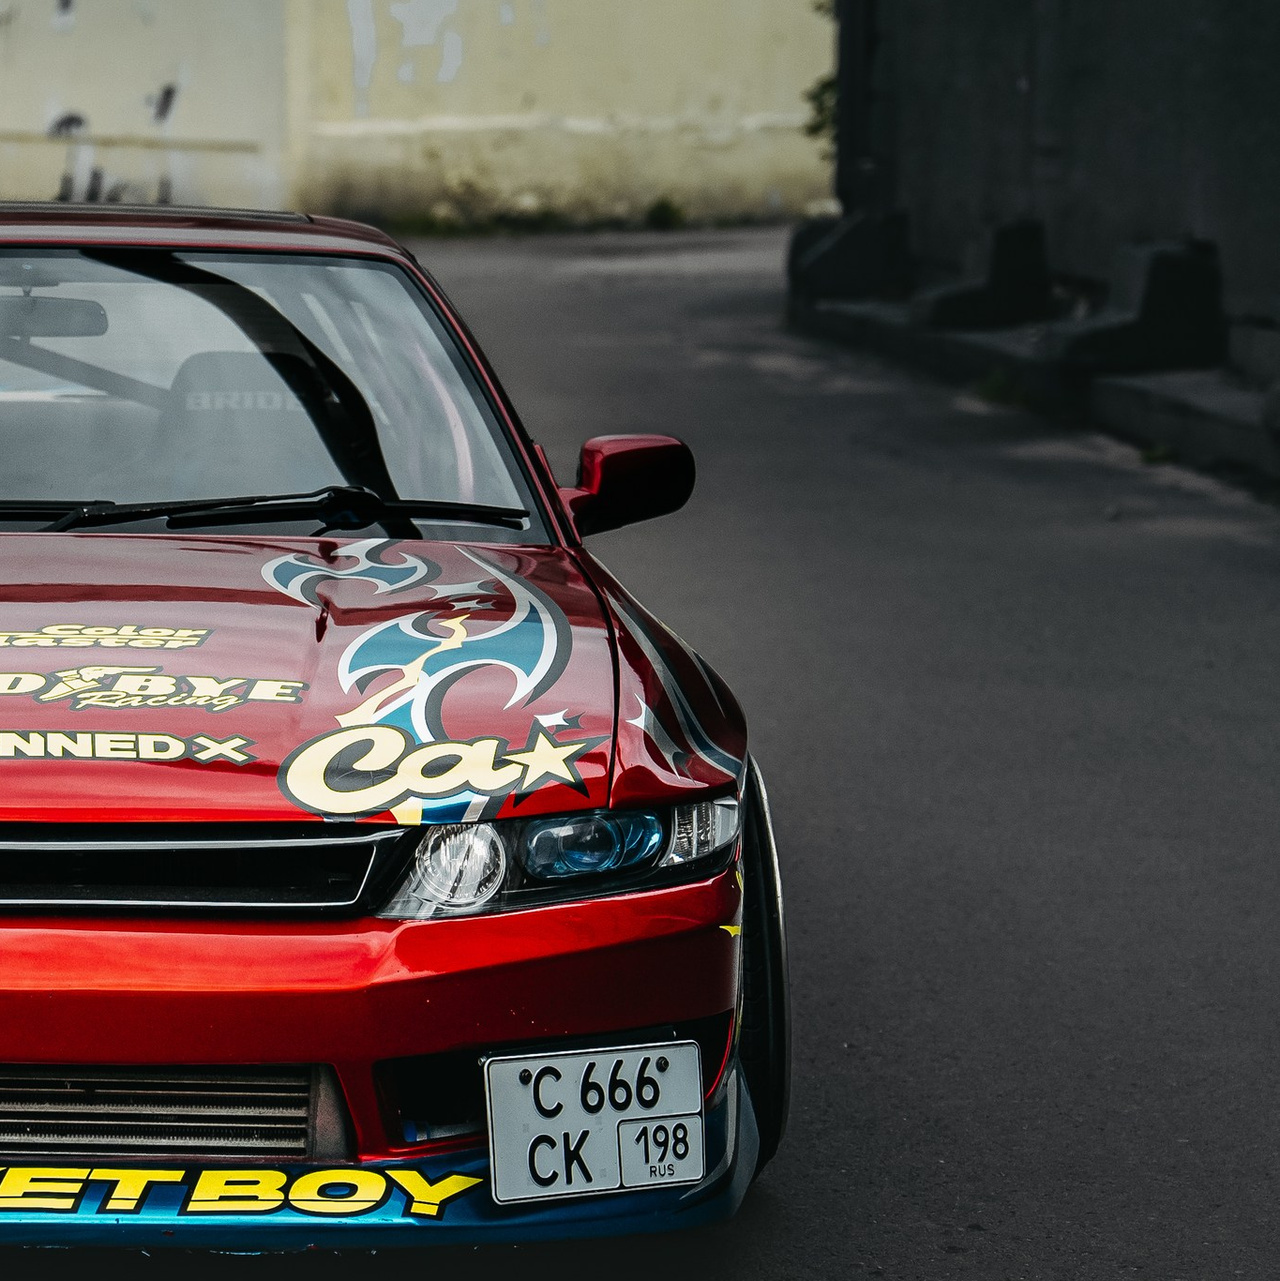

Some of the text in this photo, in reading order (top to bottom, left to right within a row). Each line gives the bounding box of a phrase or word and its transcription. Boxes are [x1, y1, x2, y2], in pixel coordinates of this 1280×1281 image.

[41, 624, 208, 637] Color
[76, 690, 244, 711] Racing
[580, 1056, 660, 1114] 666
[634, 1122, 689, 1164] 198
[649, 1163, 675, 1178] RUS
[186, 1168, 483, 1217] BOY
